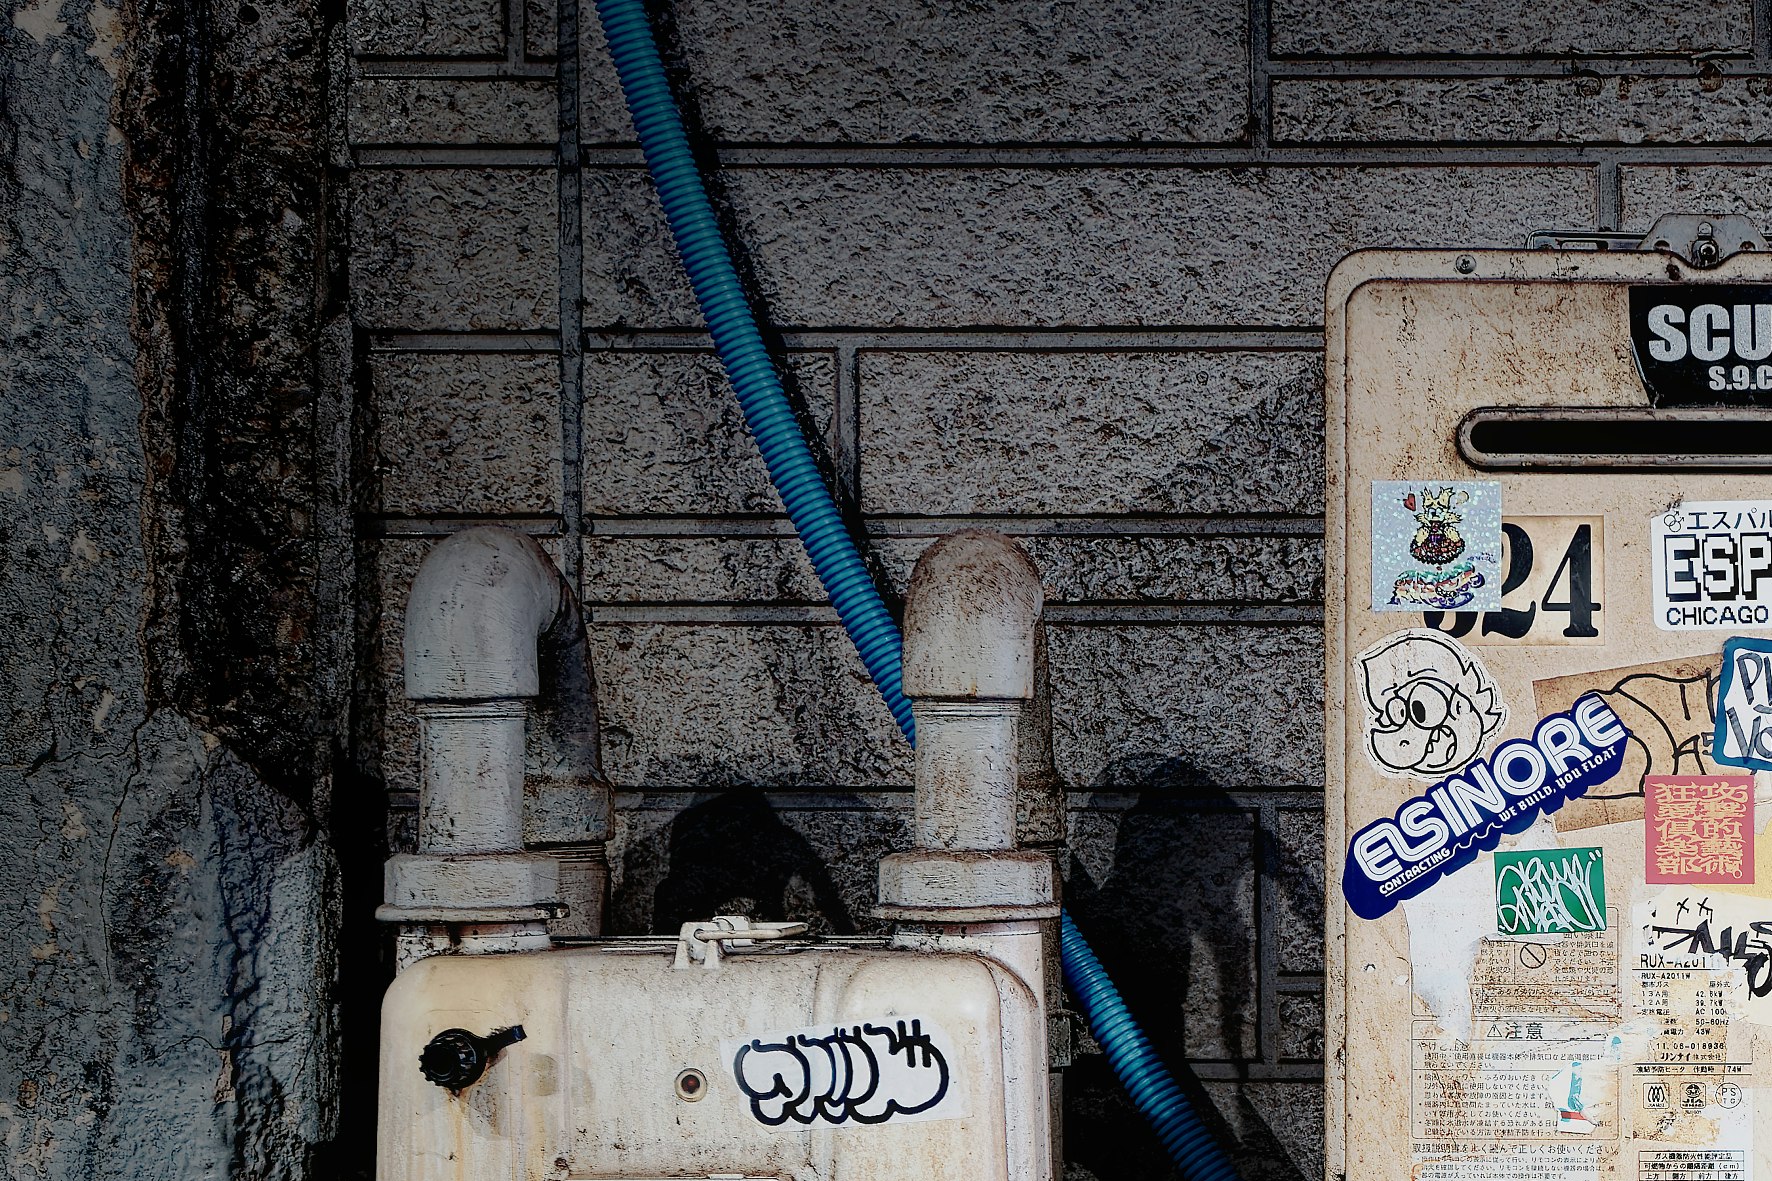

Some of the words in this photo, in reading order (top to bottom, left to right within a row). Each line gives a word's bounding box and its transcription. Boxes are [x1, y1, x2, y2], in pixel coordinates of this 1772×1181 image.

[1423, 523, 1601, 639] 24
[1666, 605, 1768, 626] CHICAGO
[1499, 806, 1519, 823] WE
[1519, 784, 1557, 813] BUILD,
[1556, 767, 1582, 790] YOU
[1581, 746, 1616, 772] FLOAT
[1379, 847, 1450, 894] CONTRACTING
[1505, 1023, 1544, 1040] 注意
